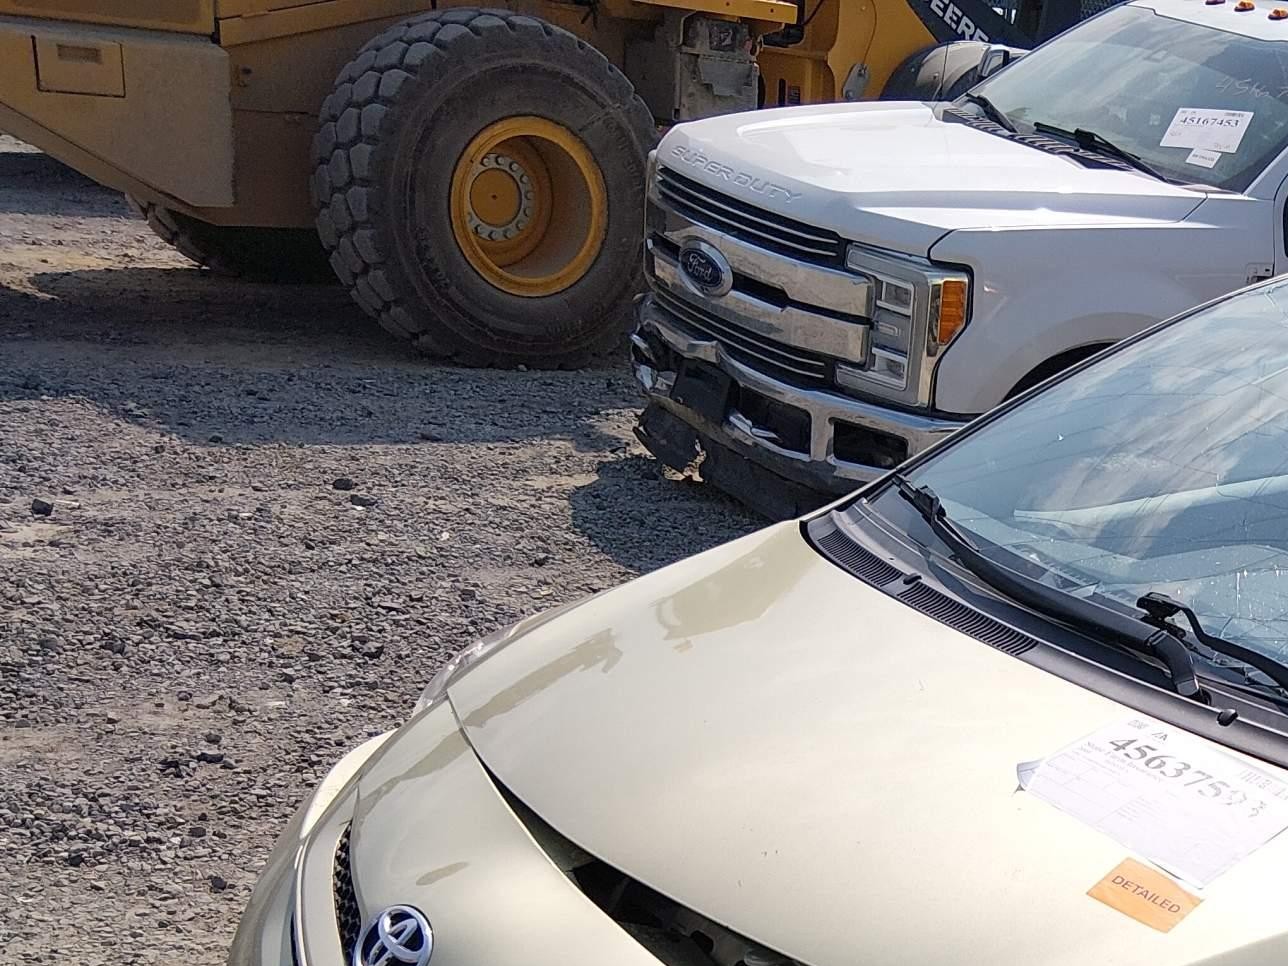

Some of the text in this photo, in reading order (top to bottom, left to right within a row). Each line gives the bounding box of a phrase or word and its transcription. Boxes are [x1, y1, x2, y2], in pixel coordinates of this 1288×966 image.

[1179, 116, 1240, 128] 45167453
[671, 145, 735, 181] SUPER
[734, 171, 803, 203] DUTY
[687, 254, 713, 281] Ford
[1111, 875, 1181, 914] DETAILED
